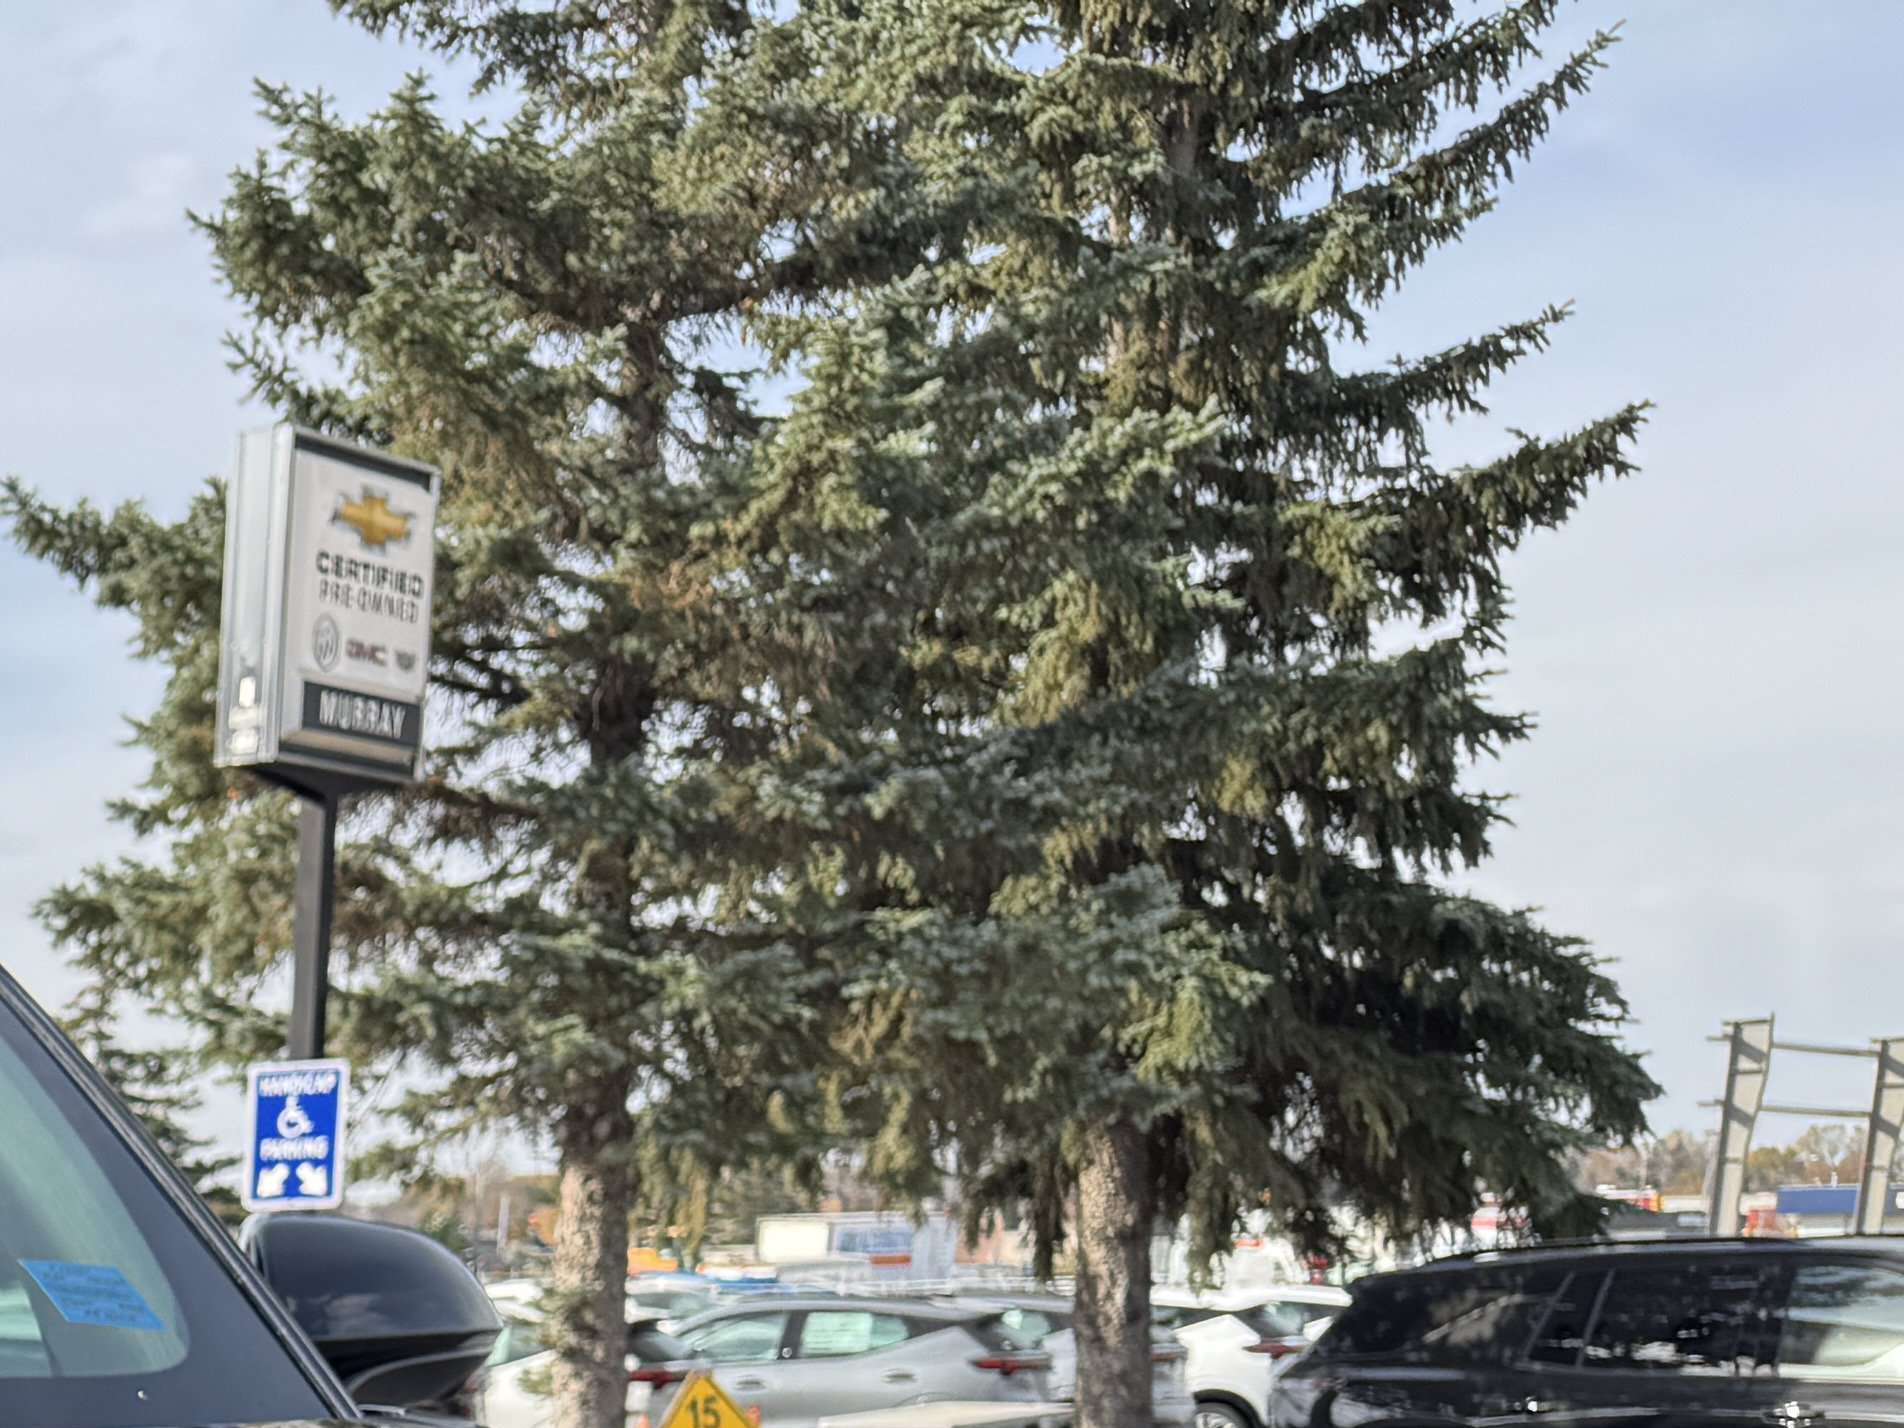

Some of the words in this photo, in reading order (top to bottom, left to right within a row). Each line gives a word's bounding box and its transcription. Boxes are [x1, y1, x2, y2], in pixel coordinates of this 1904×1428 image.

[315, 549, 424, 599] CERTIFIED
[319, 689, 406, 739] MURRAY
[260, 1135, 329, 1161] PARKING
